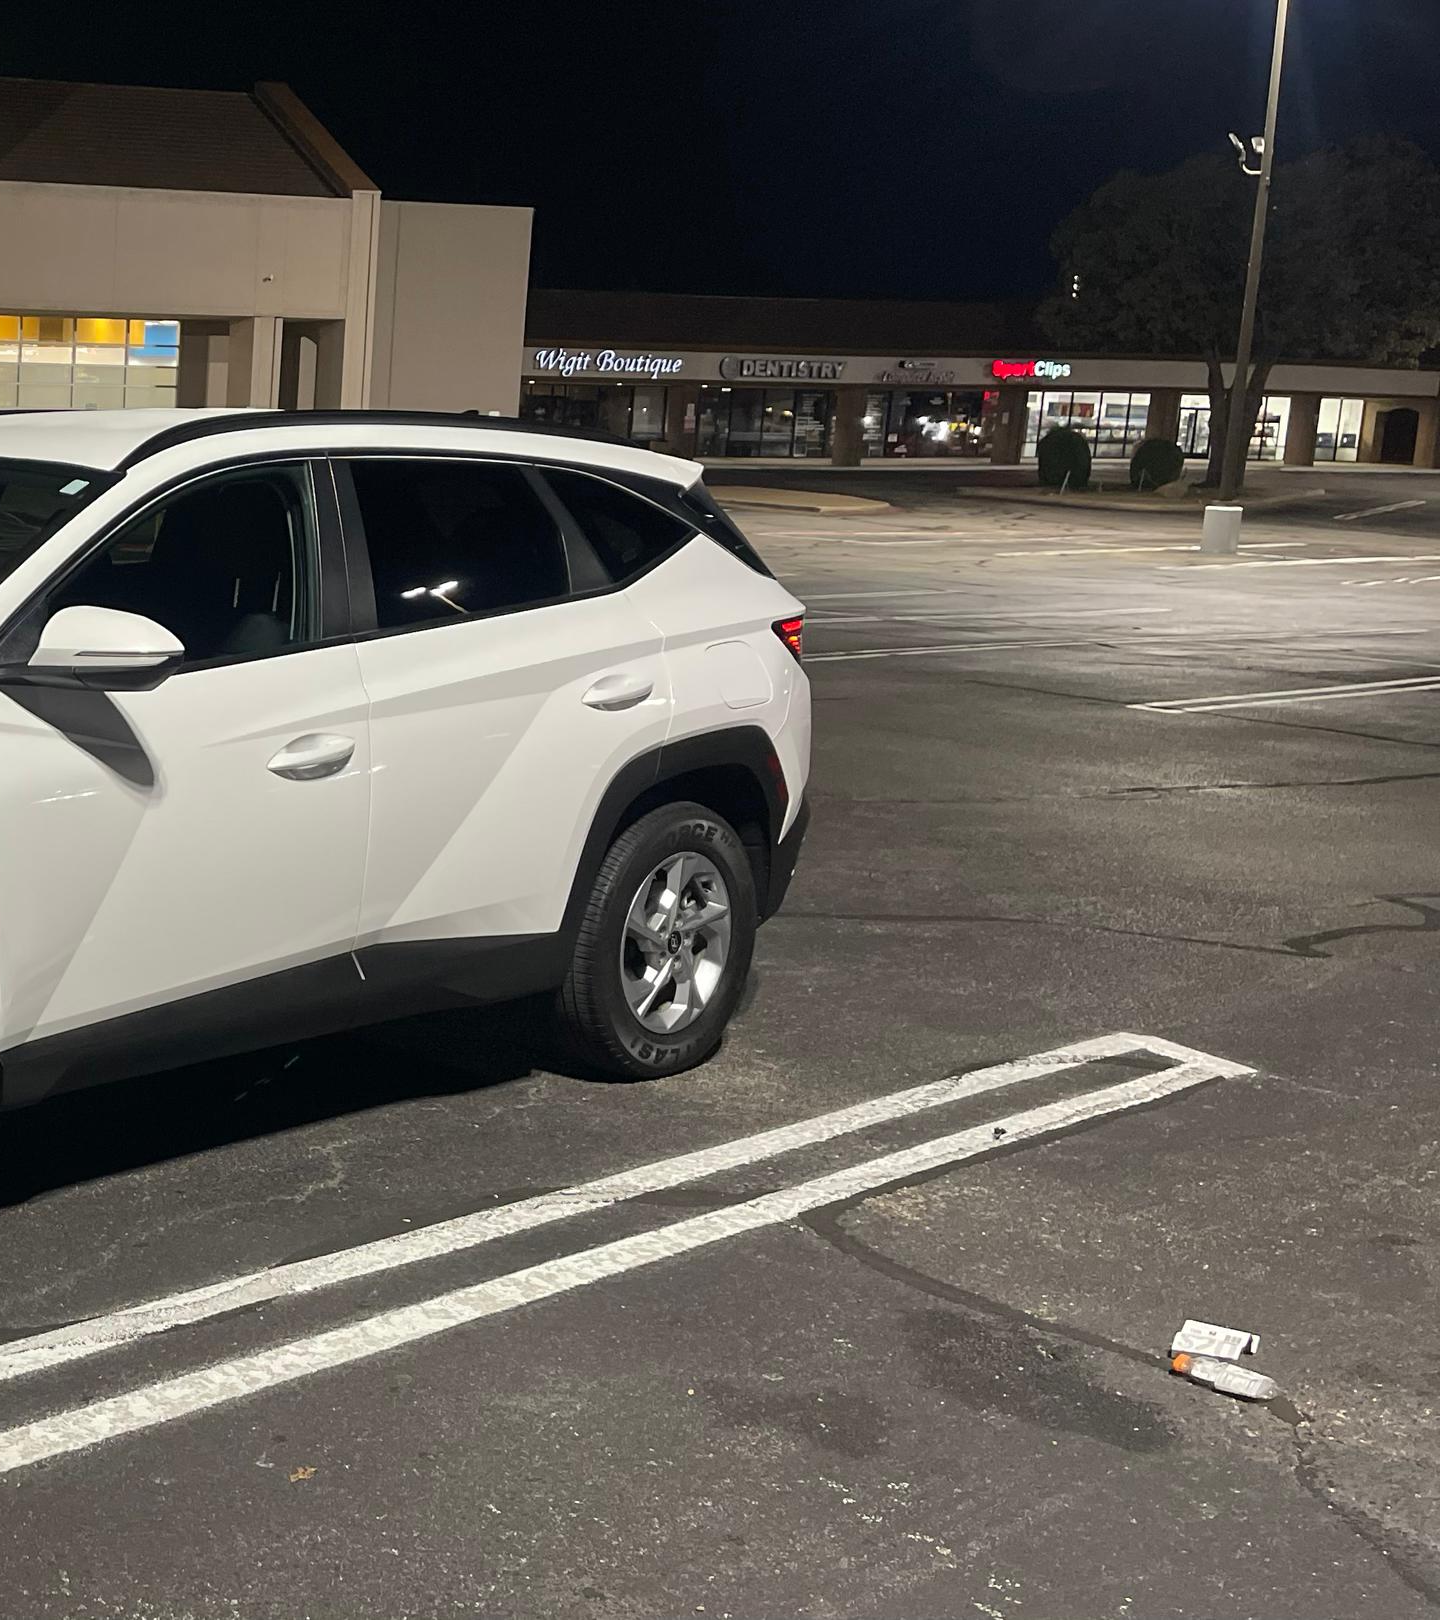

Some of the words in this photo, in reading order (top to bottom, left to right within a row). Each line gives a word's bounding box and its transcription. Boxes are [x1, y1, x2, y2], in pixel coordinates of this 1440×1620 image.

[536, 348, 591, 377] Wigit
[597, 350, 683, 380] Boutique
[741, 360, 846, 380] DENTISTRY
